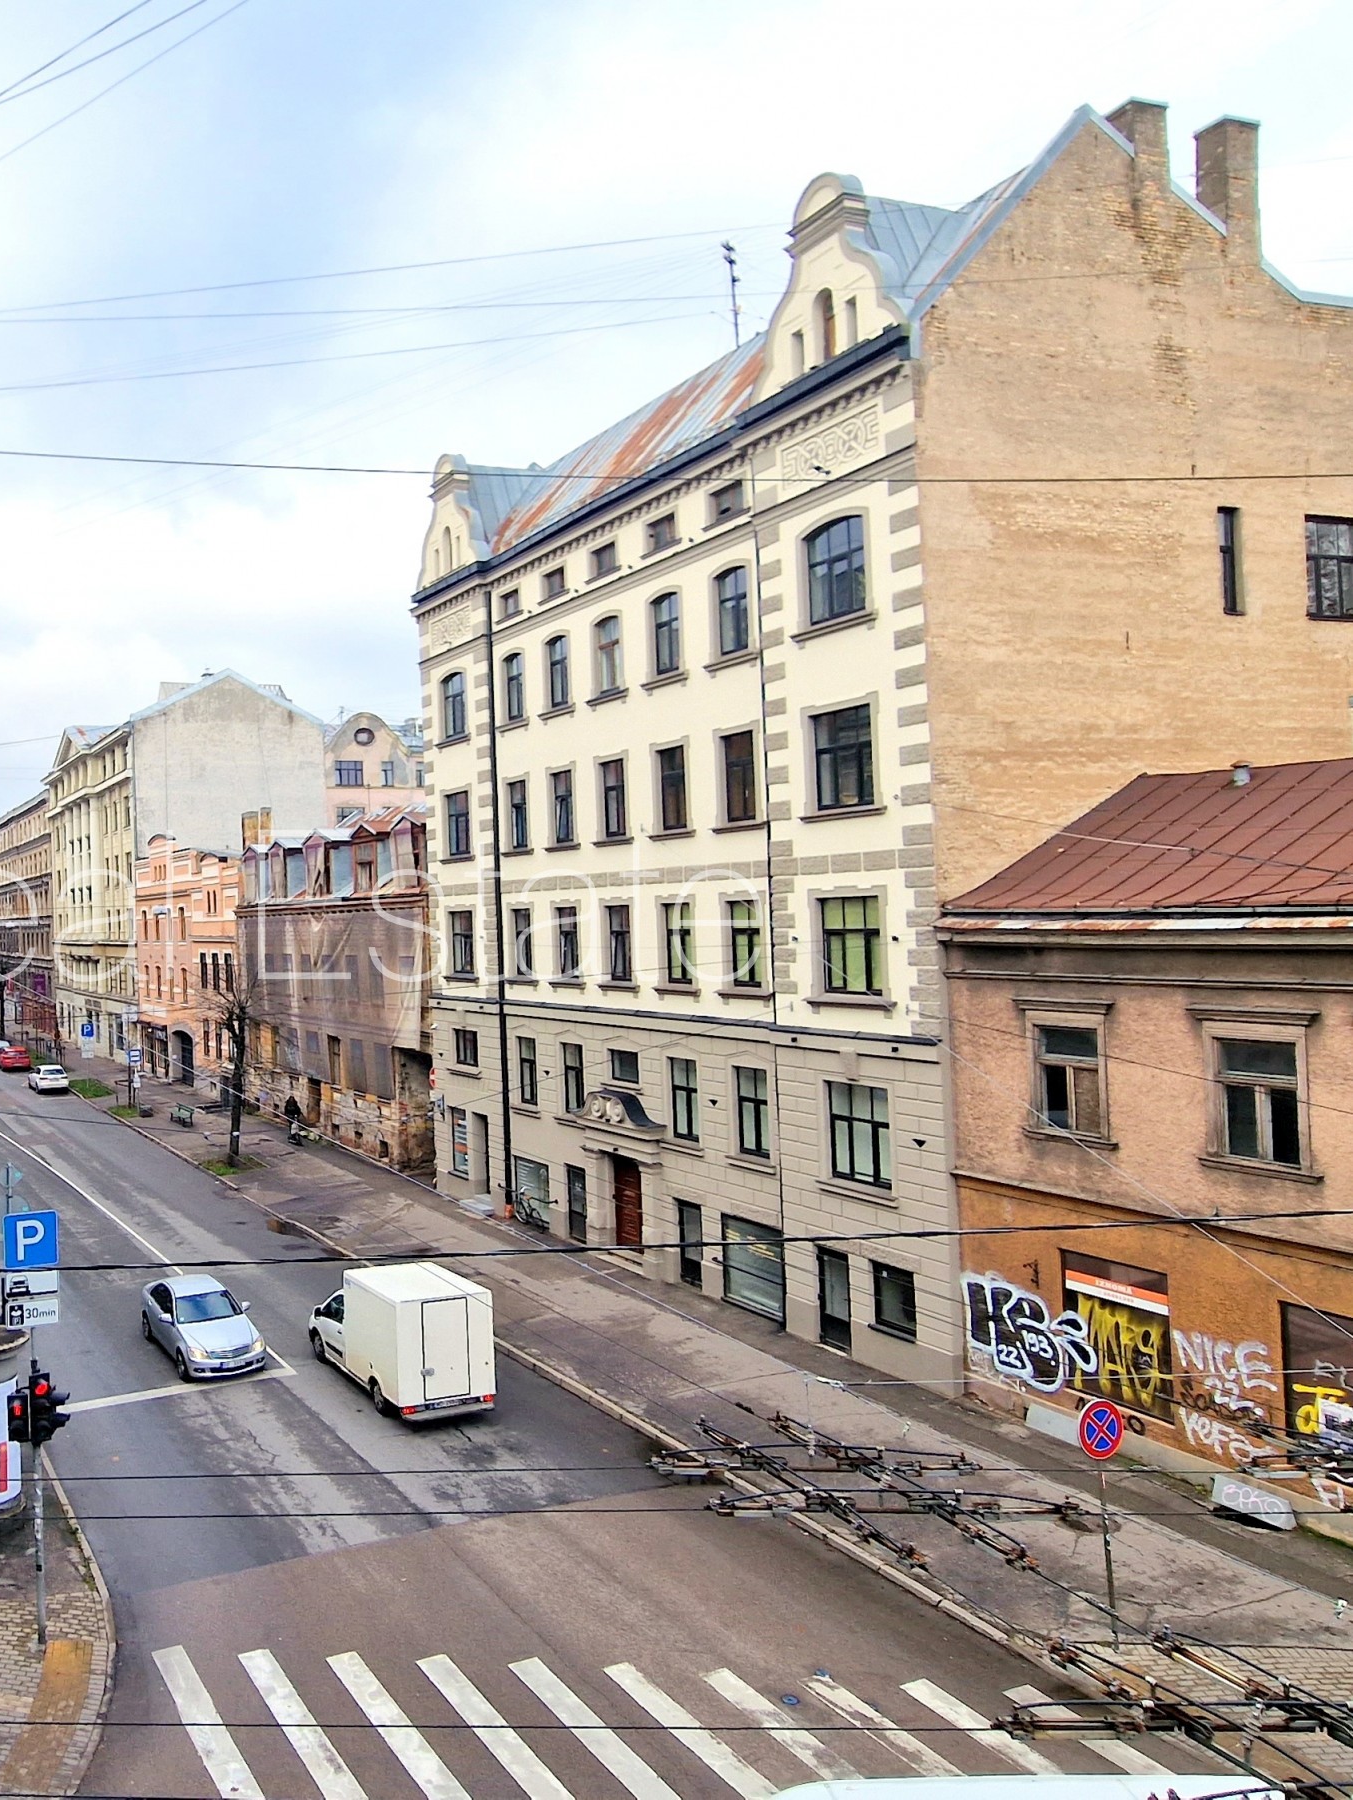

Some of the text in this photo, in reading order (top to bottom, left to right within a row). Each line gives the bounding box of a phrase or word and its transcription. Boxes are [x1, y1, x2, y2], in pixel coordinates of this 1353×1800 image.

[84, 1025, 91, 1036] P
[16, 1219, 45, 1262] P
[25, 1307, 56, 1320] 30min
[1172, 1328, 1278, 1393] NICE
